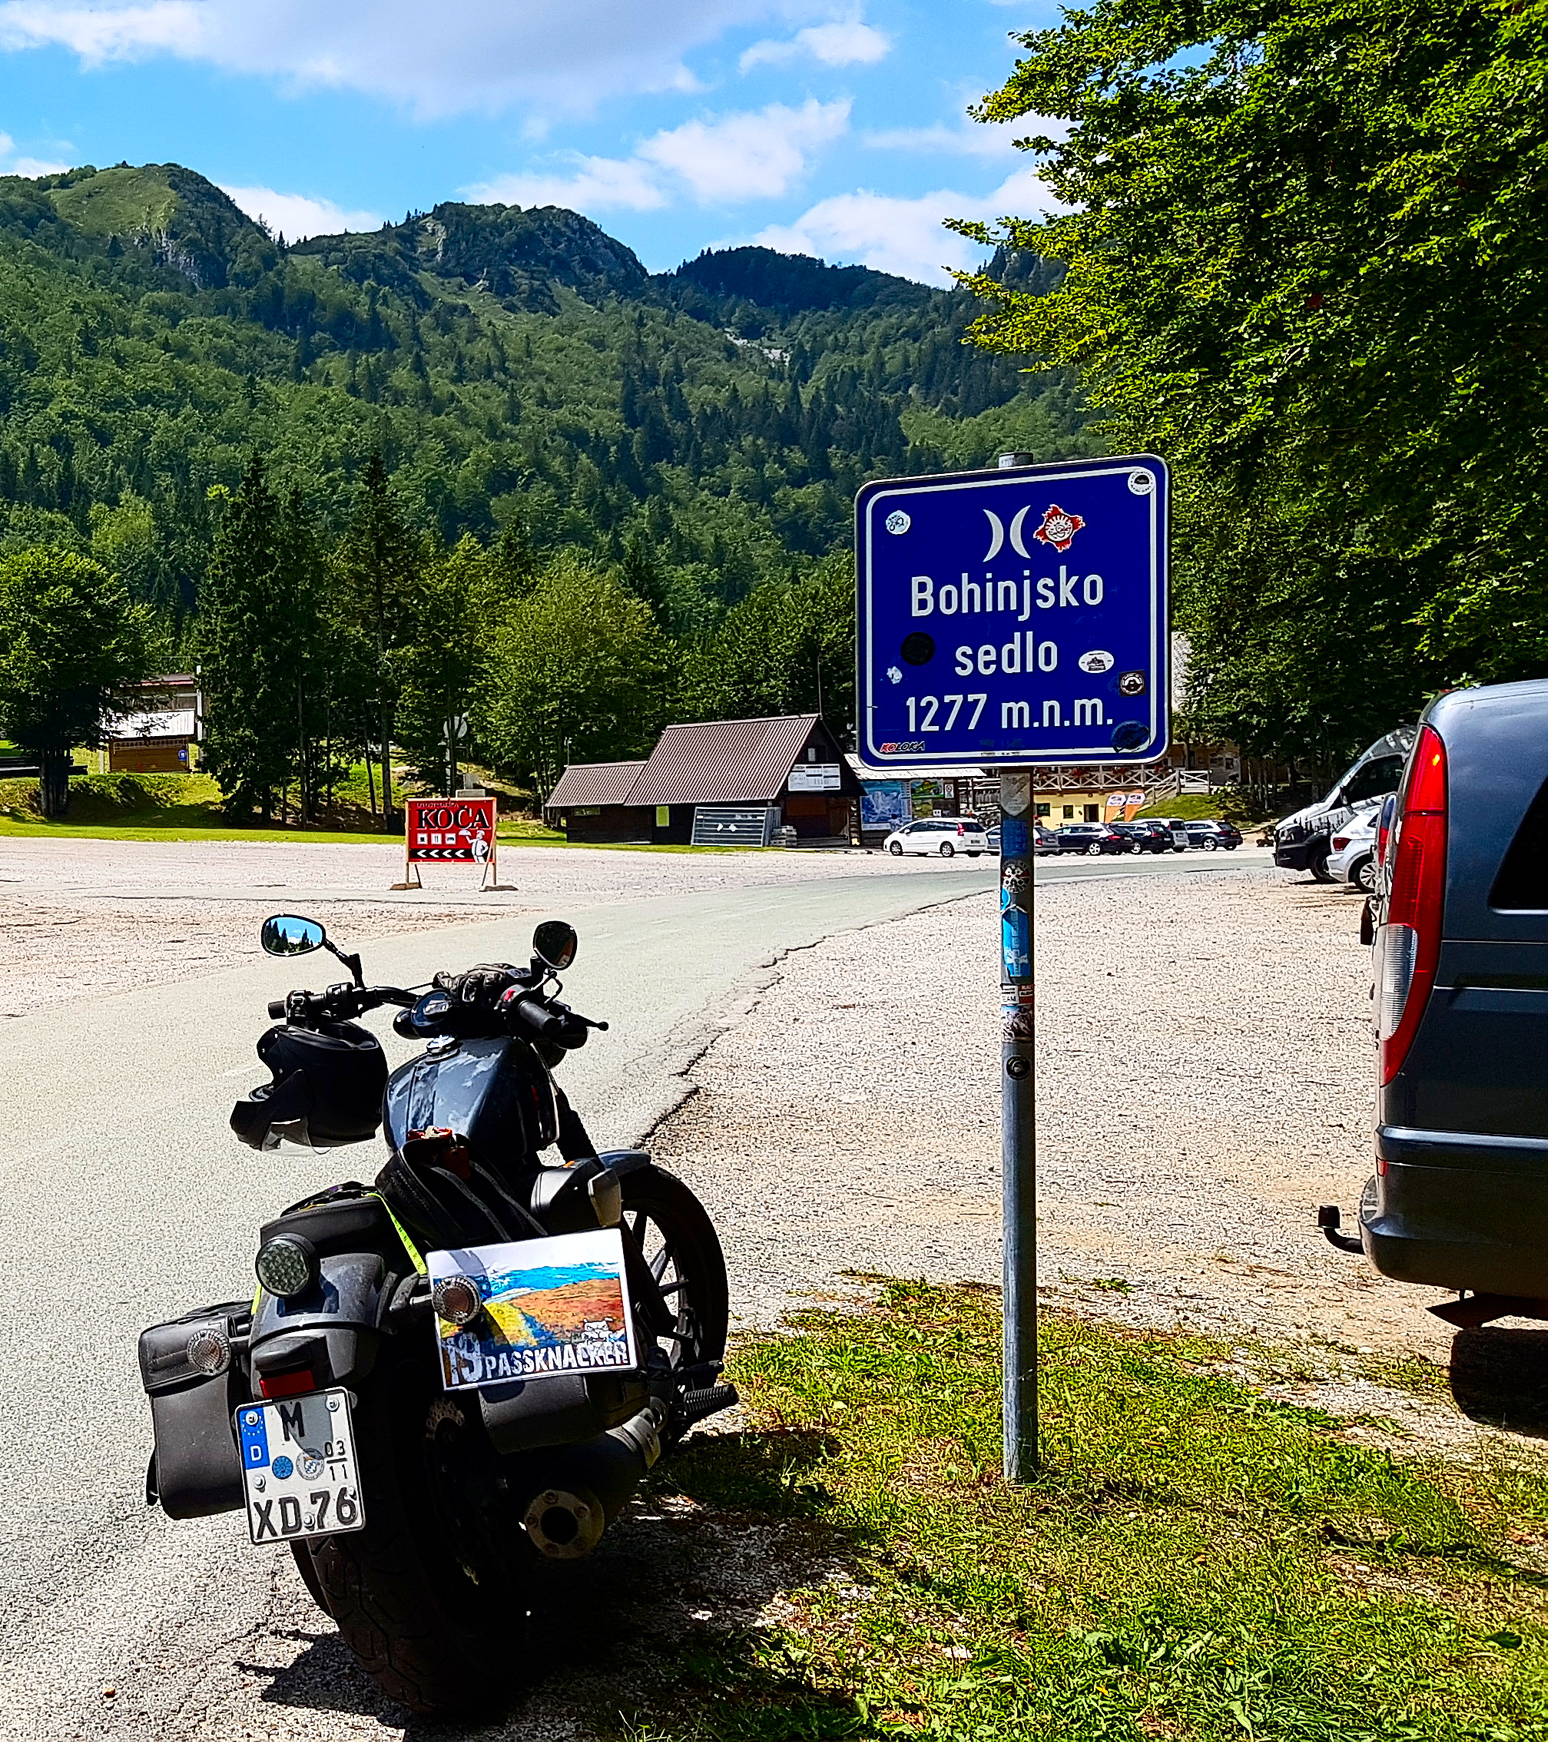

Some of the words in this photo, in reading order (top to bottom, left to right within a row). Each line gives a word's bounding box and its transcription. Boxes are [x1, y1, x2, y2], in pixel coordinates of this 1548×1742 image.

[911, 565, 1104, 621] Bohinjsko
[954, 631, 1058, 676] sedlo
[905, 693, 988, 732] 1277
[1001, 697, 1113, 729] m.n.m.
[879, 740, 926, 753] KOLOKA
[416, 805, 492, 830] KOČA
[484, 1340, 628, 1380] PASSKNACKER
[280, 1401, 305, 1442] M
[250, 1445, 262, 1461] D
[324, 1440, 346, 1457] 03
[329, 1464, 348, 1481] 11
